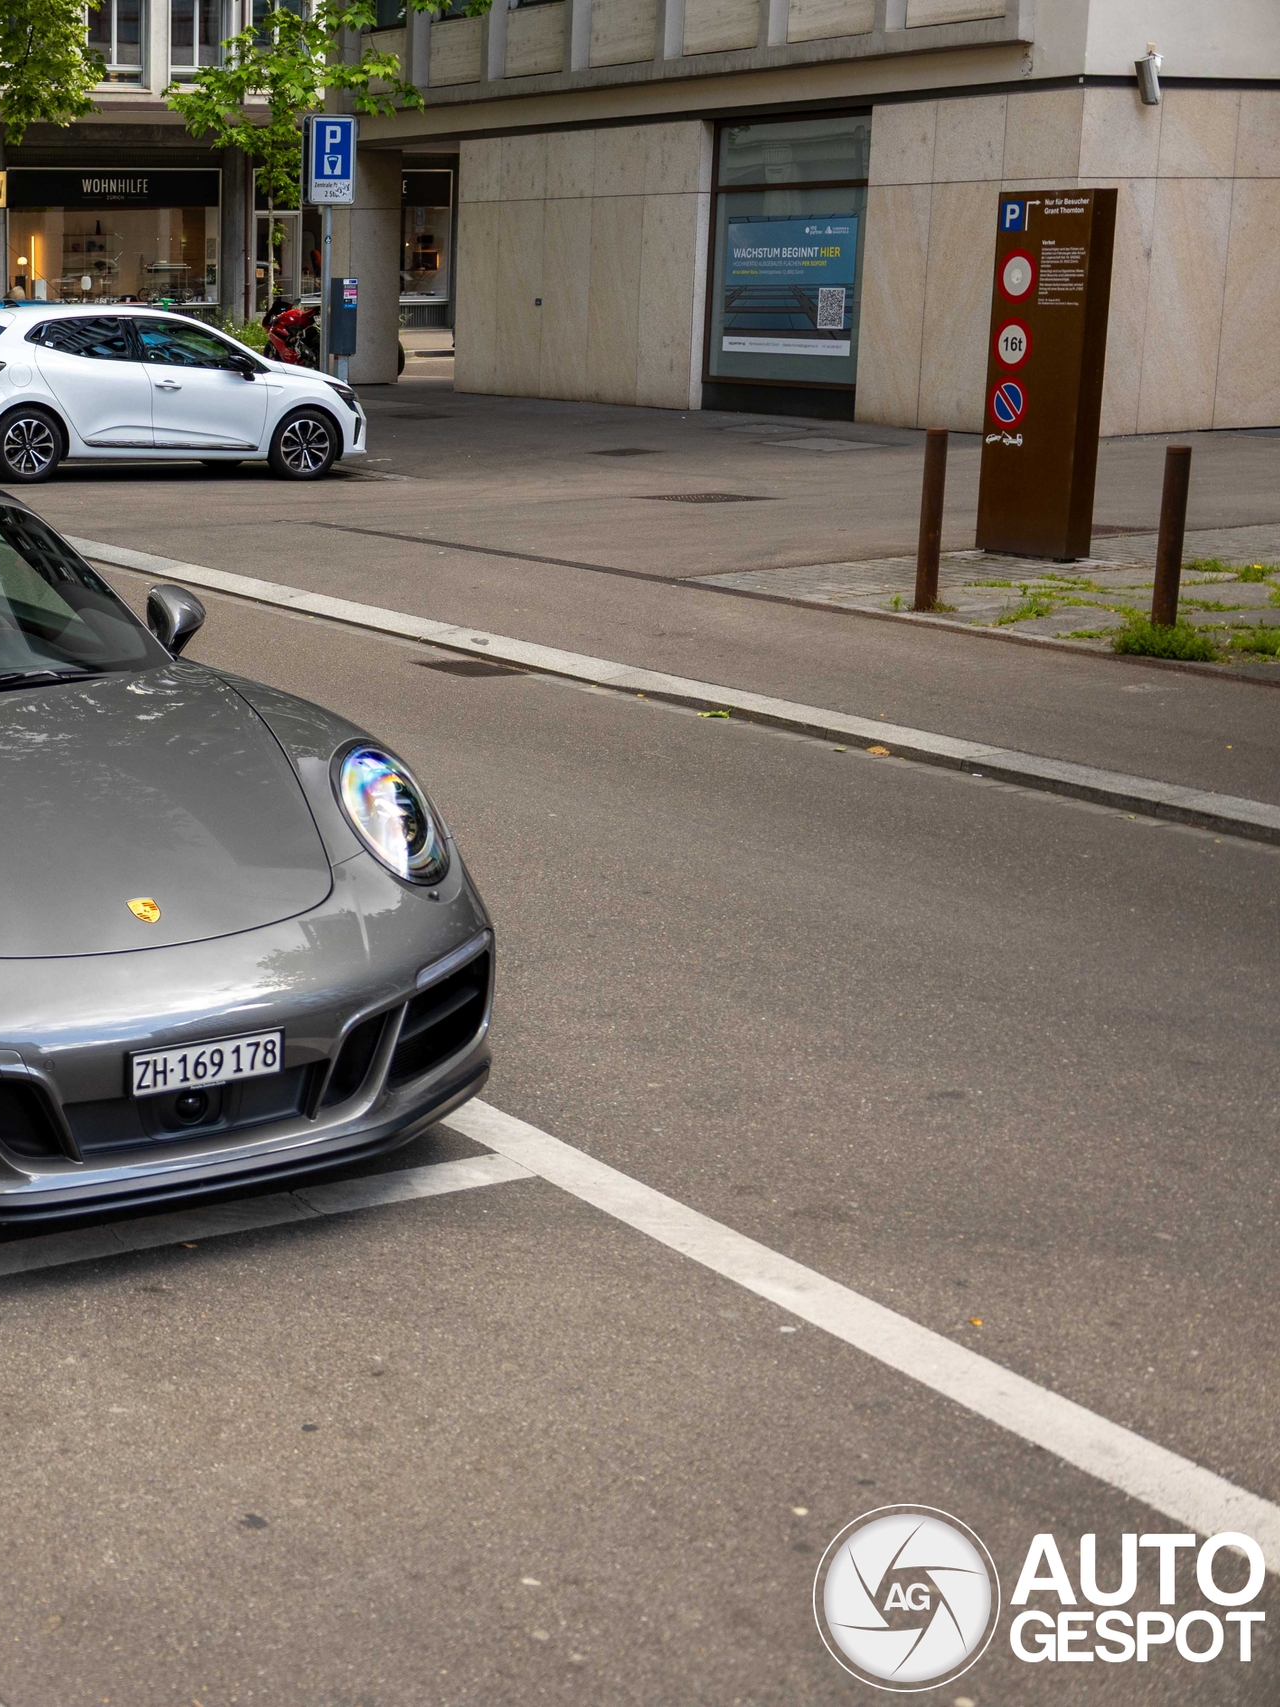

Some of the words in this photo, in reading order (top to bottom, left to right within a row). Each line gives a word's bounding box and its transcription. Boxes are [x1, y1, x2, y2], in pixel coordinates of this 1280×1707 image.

[325, 125, 341, 153] P
[82, 179, 148, 193] WOHNHILFE
[1005, 204, 1020, 228] P
[733, 247, 780, 258] WACHSTUM
[782, 247, 818, 258] BEGINNT
[820, 246, 841, 257] HIER
[1003, 336, 1023, 352] 16t
[231, 1038, 277, 1073] 178
